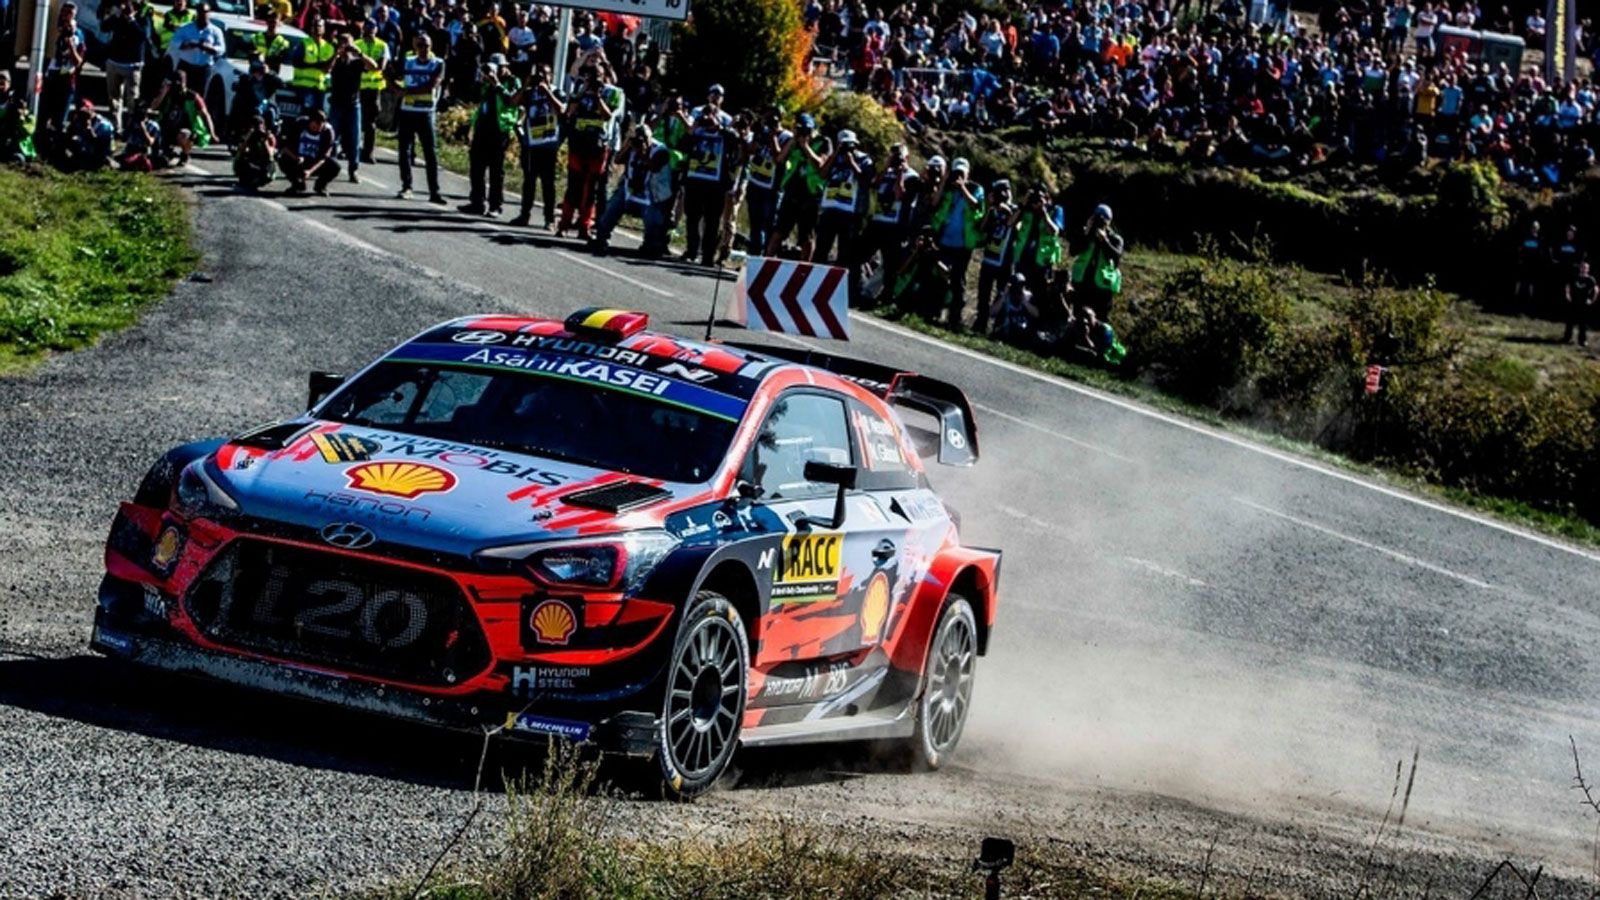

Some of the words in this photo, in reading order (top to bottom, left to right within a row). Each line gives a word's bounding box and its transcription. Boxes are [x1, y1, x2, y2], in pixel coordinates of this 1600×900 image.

[367, 433, 499, 459] HYUNDAI
[387, 443, 569, 487] MOBIS
[788, 536, 837, 578] RACC
[538, 668, 590, 677] HYUNDAI
[538, 679, 575, 688] STEEL
[531, 721, 583, 734] MICHELIN
